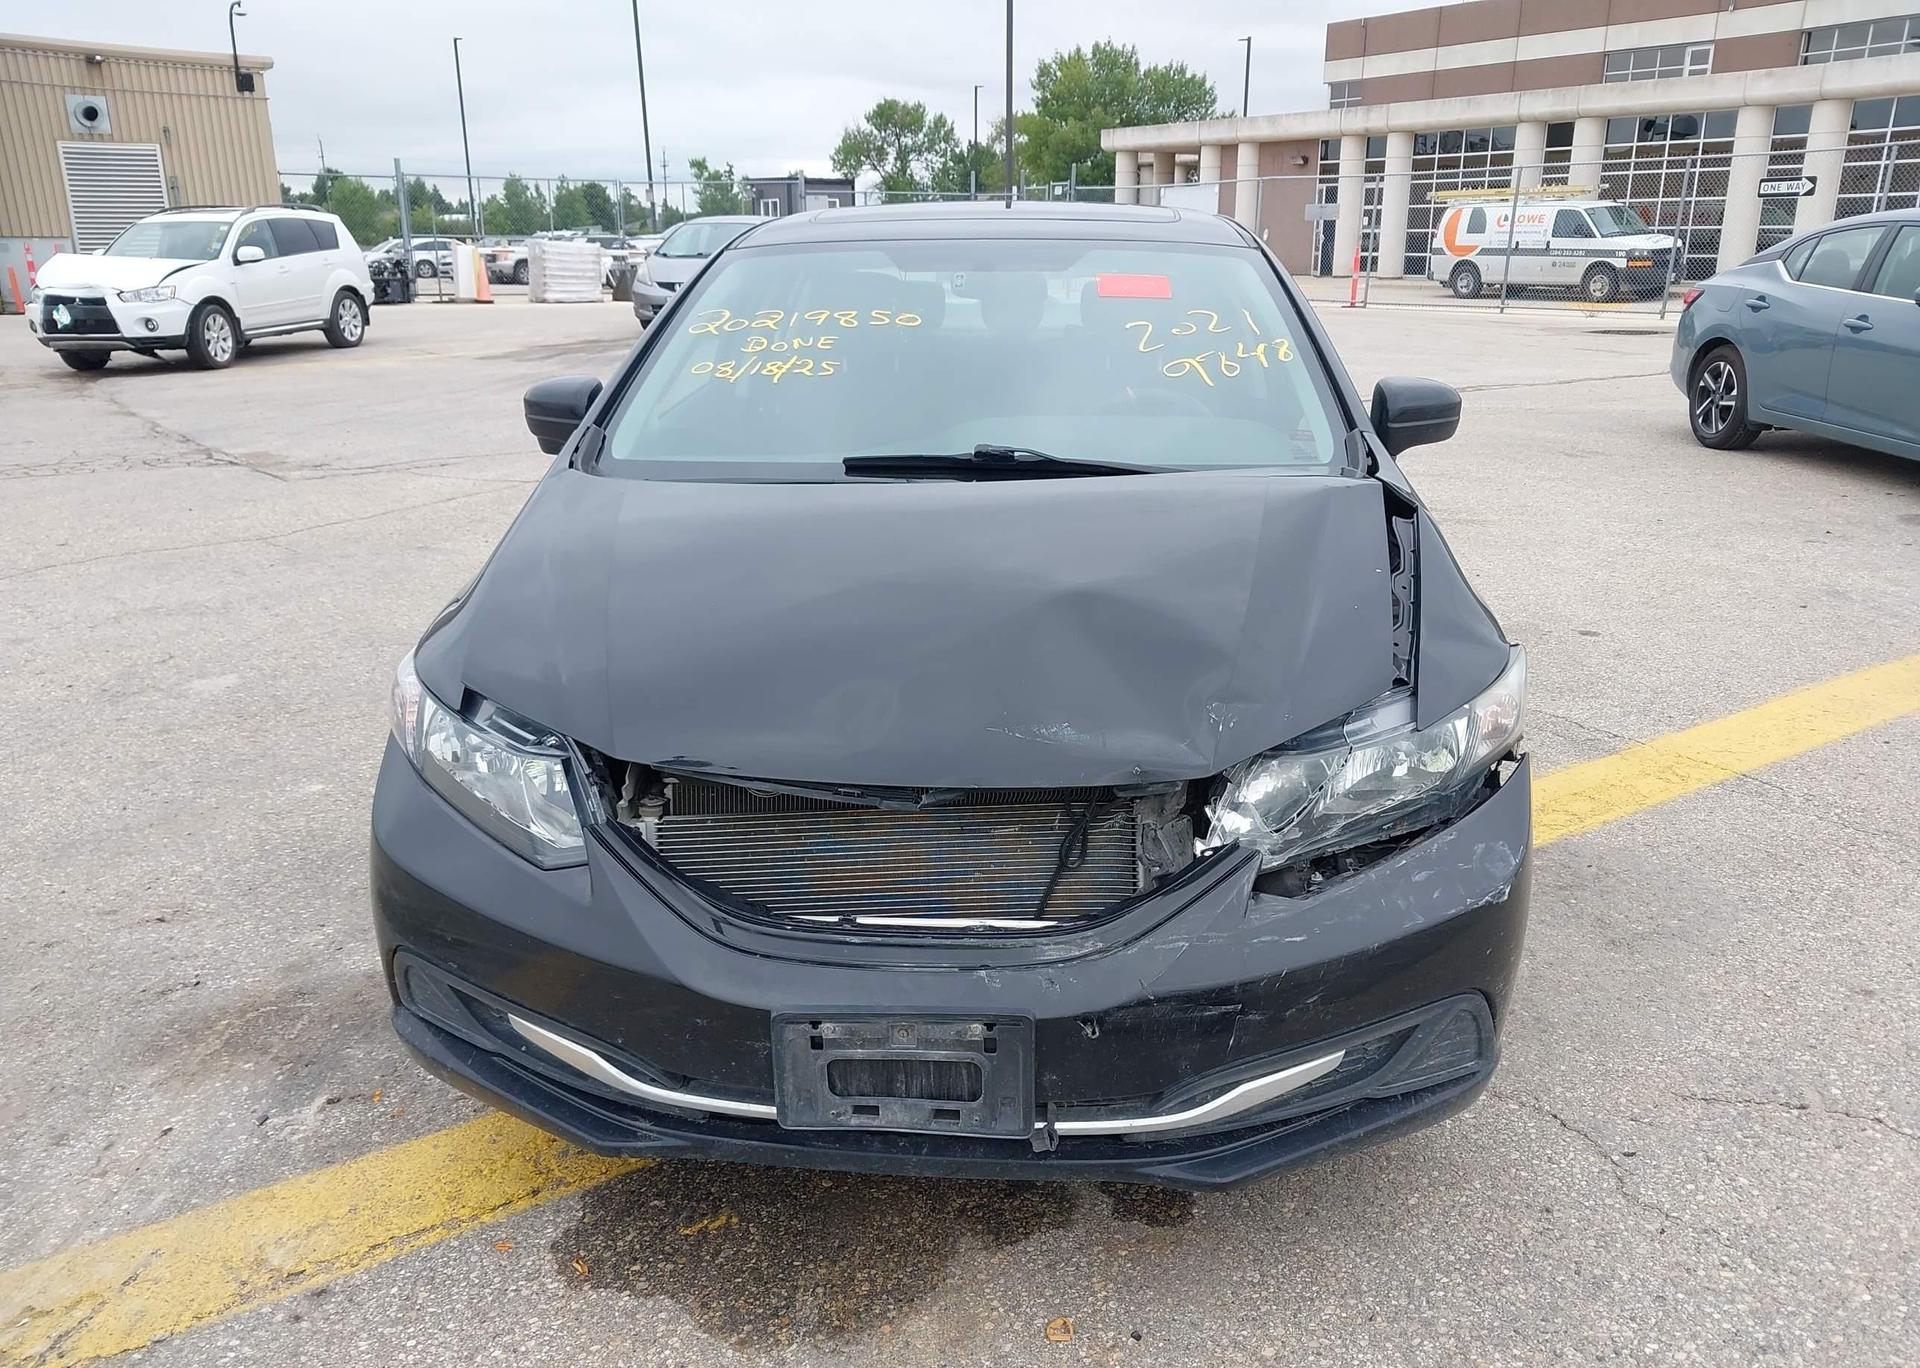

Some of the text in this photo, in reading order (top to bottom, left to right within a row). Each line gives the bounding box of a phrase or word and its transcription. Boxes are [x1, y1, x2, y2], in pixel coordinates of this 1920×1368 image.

[1762, 182, 1807, 192] ONE WAY
[1513, 214, 1546, 224] OWE
[688, 309, 923, 335] 20219850
[1125, 309, 1261, 353] 2021
[741, 336, 839, 353] DONE
[691, 354, 840, 384] 08/18/25
